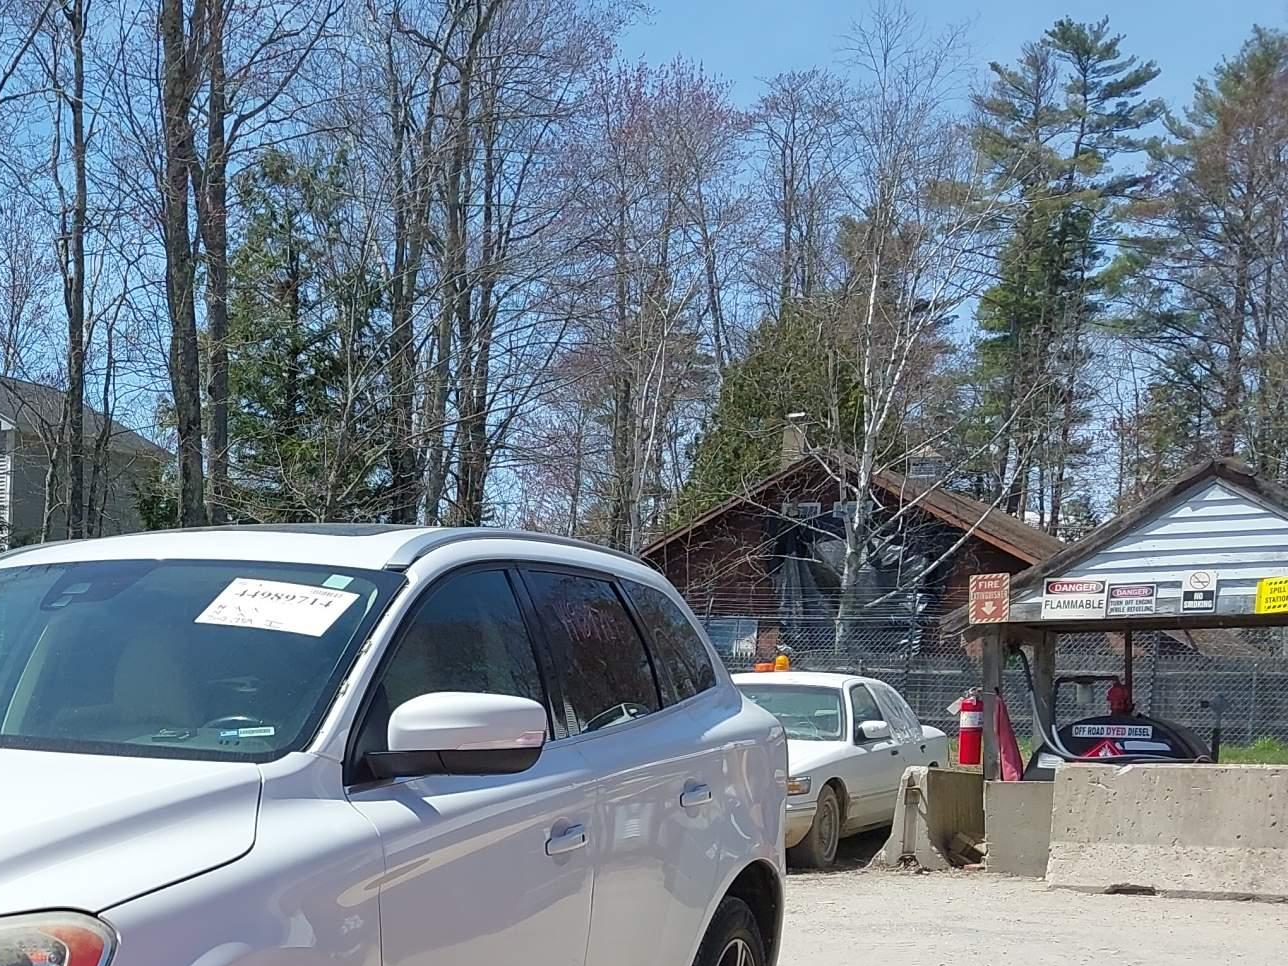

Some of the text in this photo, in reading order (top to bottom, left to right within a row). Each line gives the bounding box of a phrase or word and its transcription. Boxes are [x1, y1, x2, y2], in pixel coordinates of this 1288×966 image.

[978, 580, 1000, 589] FIRE
[1054, 583, 1097, 592] DANGER
[1116, 588, 1148, 596] DANGER
[1269, 586, 1287, 594] SPILL
[234, 588, 334, 608] 44989714
[1193, 592, 1204, 600] NO
[1044, 599, 1104, 609] FLAMMABLE
[1183, 600, 1213, 608] SMOKING
[1074, 727, 1150, 737] OFF ROAD DYED DIESEL
